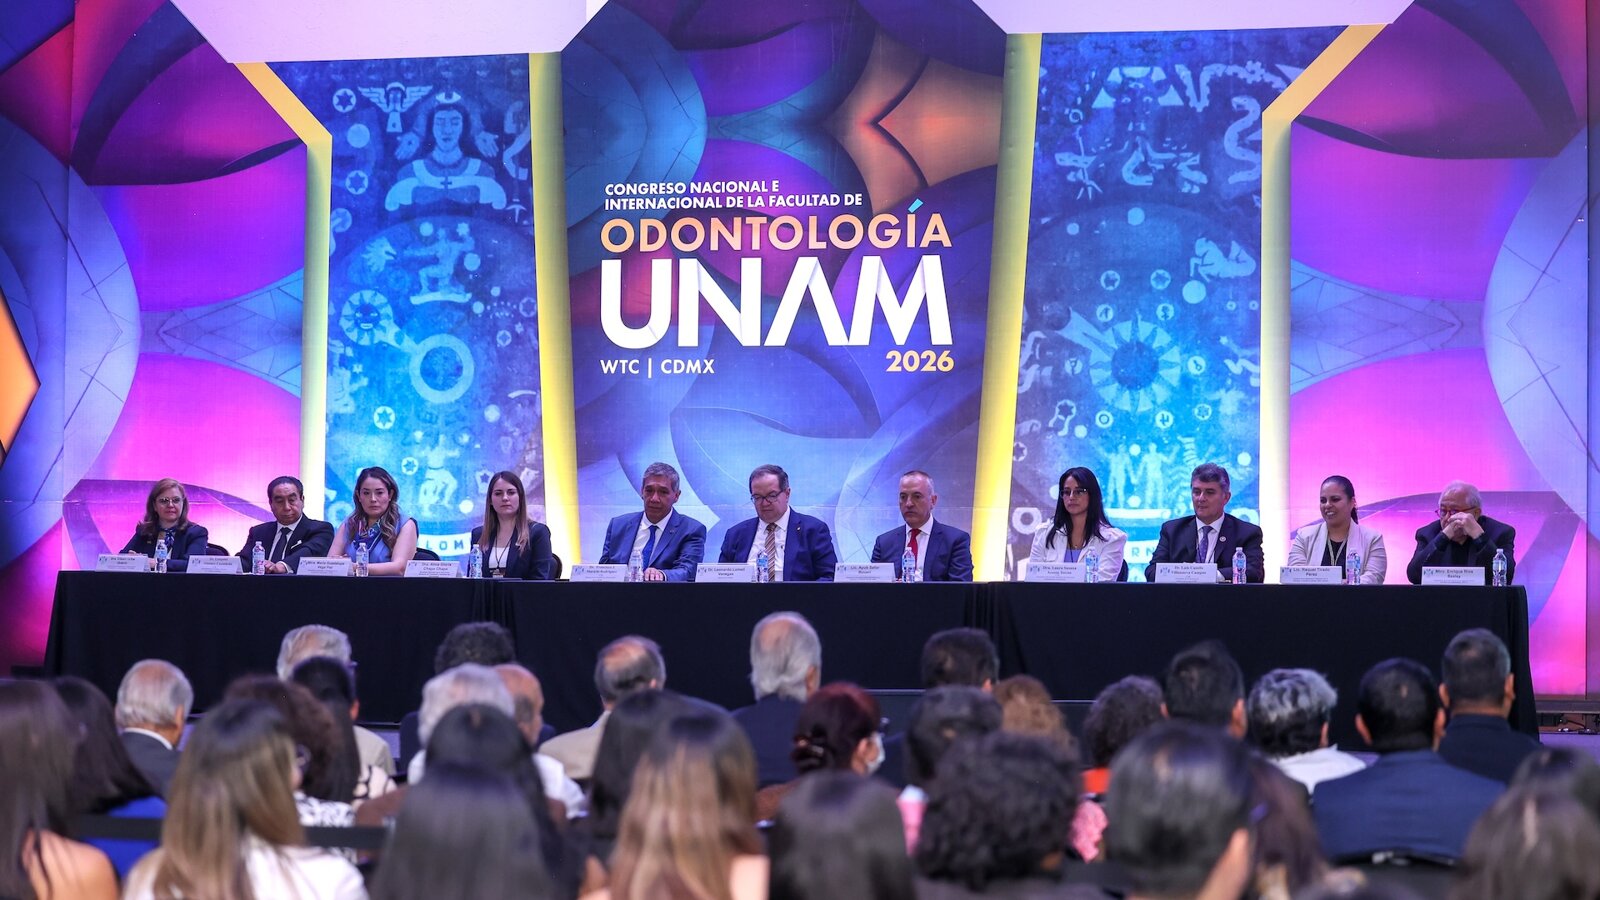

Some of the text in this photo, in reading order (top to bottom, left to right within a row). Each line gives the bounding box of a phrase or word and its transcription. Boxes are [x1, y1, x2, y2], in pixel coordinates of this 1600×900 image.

[605, 180, 780, 196] CONGRESO NACIONAL E
[605, 194, 862, 210] INTERNACIONAL DE LA FACULTAD DE
[601, 198, 952, 253] ODONTOLOGÍA
[600, 254, 953, 349] UNAM
[600, 360, 640, 374] WTC
[660, 358, 715, 374] CDMX
[886, 350, 954, 372] 2026
